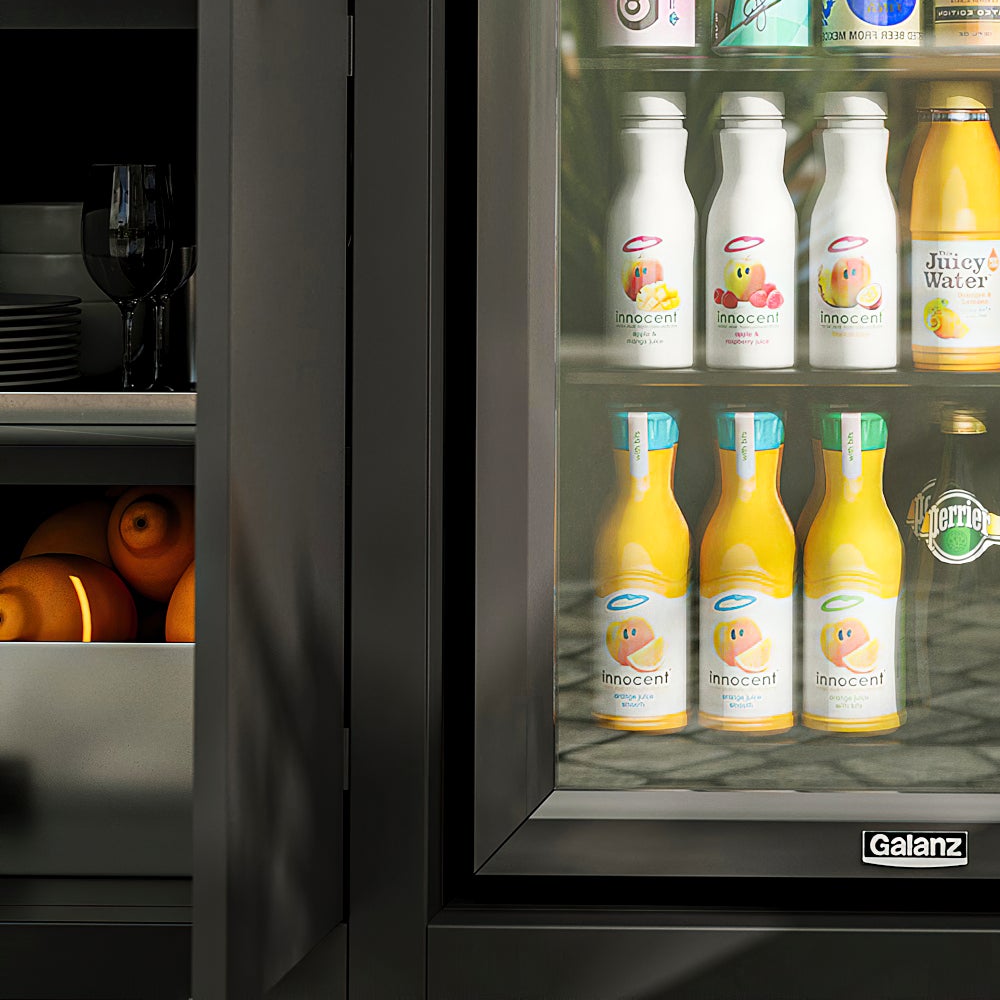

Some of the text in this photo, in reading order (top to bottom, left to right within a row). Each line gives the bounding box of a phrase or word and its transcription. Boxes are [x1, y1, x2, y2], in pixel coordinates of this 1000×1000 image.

[926, 252, 986, 275] Juicy
[923, 271, 988, 289] Water
[615, 310, 677, 324] innocent
[717, 310, 779, 324] innocent
[820, 310, 884, 324] innocent
[601, 669, 669, 686] innocent
[709, 670, 776, 687] innocent
[816, 671, 883, 687] innocent
[869, 833, 963, 857] Galanz
